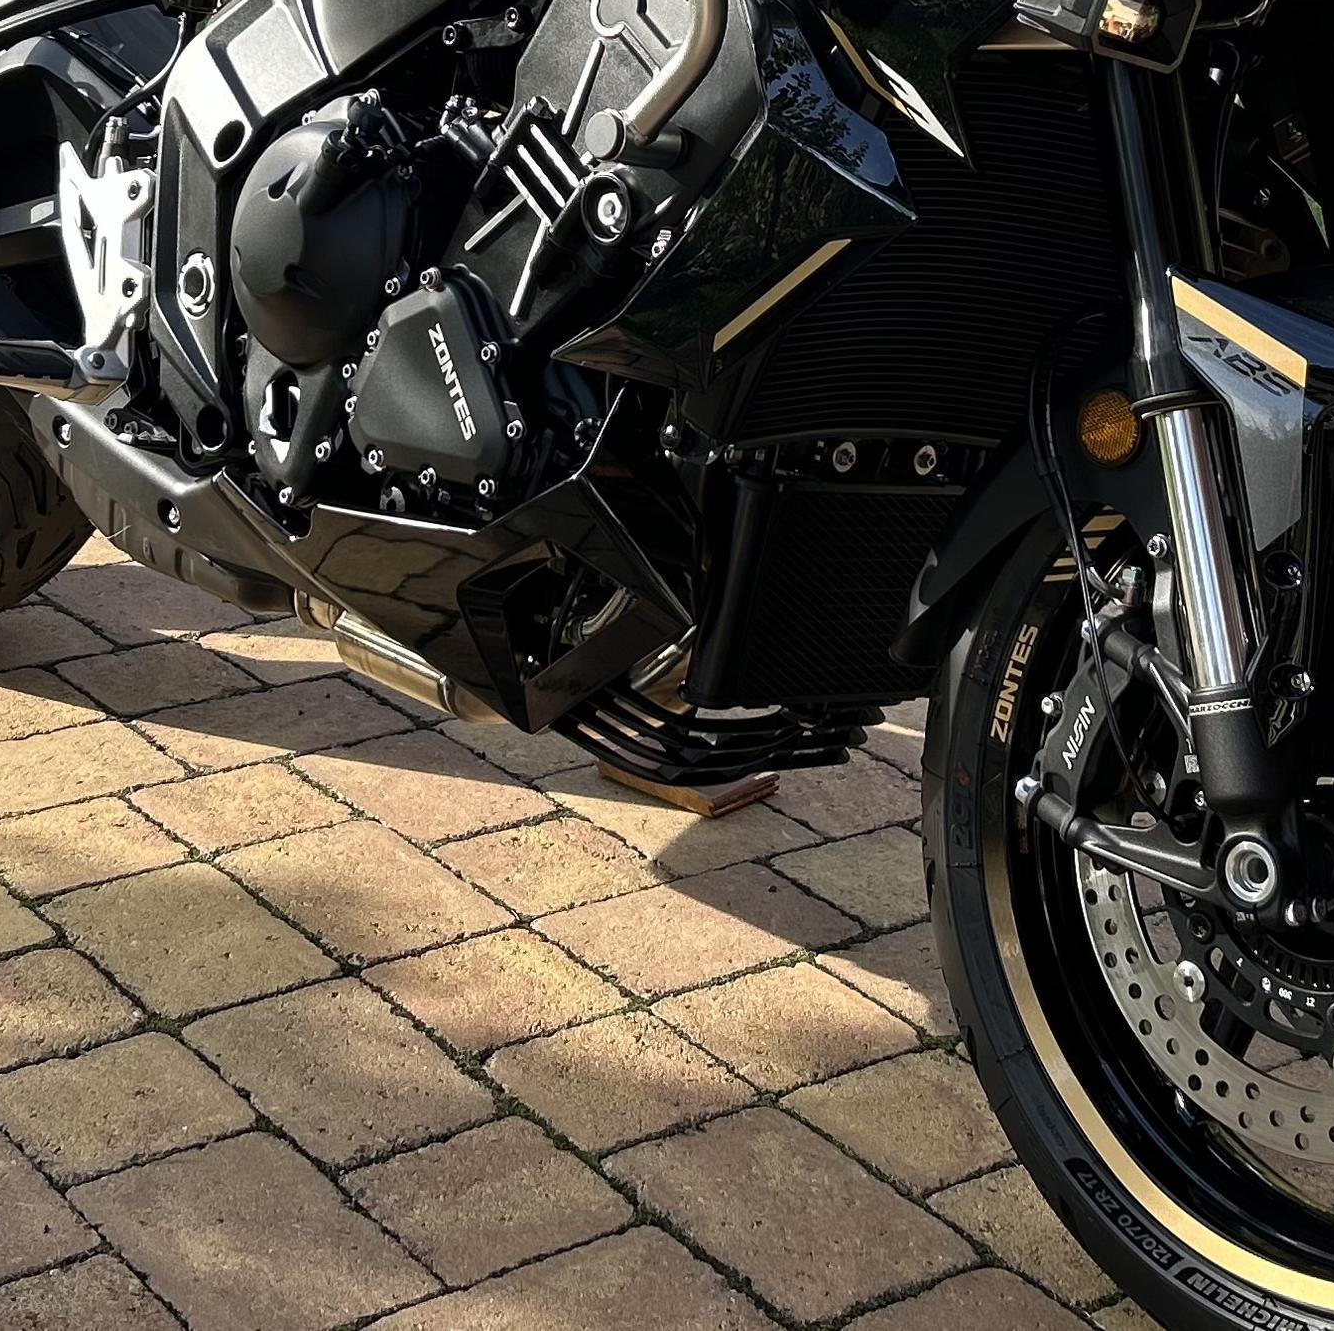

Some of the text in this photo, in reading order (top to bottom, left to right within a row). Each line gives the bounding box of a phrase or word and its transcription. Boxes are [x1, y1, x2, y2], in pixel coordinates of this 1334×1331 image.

[428, 322, 476, 441] ZONTES
[1187, 336, 1301, 397] ABS
[990, 623, 1039, 743] ZONTES
[1076, 1171, 1172, 1264] 120/70 ZR 17
